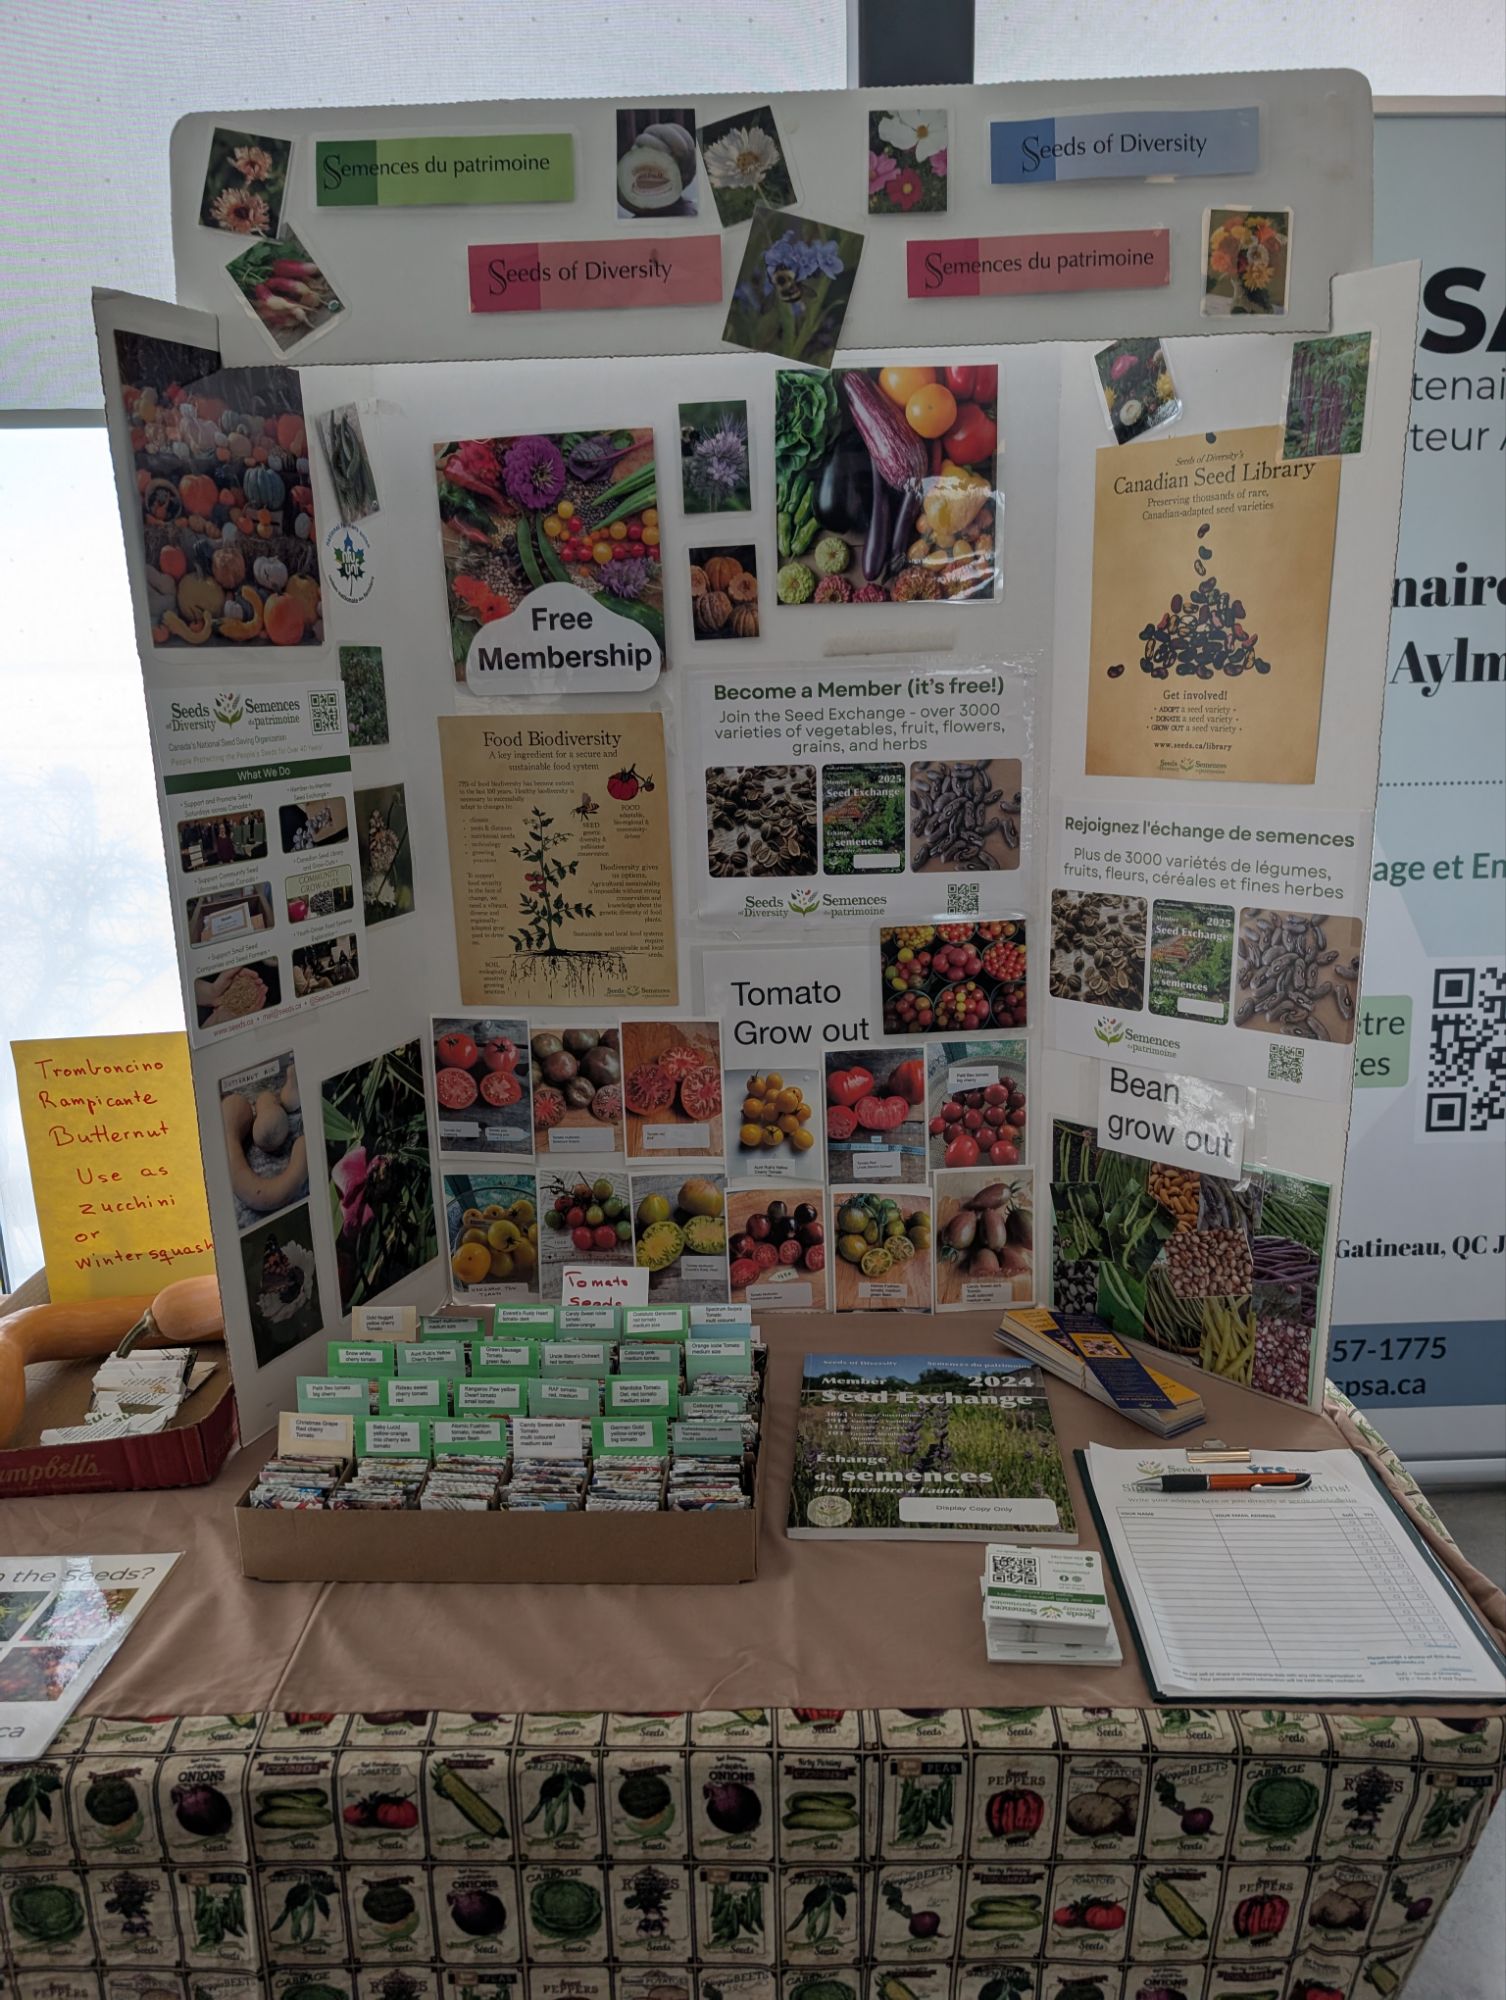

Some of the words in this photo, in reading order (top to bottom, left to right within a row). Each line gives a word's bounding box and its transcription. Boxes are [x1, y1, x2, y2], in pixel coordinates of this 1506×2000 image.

[1022, 135, 1087, 174] Seeds
[1093, 134, 1114, 154] of
[1121, 133, 1208, 158] Diversity
[323, 153, 419, 191] Semences
[425, 155, 448, 175] du
[453, 153, 551, 178] patrimoine
[488, 259, 552, 295] Seeds
[559, 260, 581, 281] of
[585, 259, 673, 285] Diversity
[925, 253, 1022, 290] Semences
[1028, 251, 1053, 271] du
[1058, 248, 1154, 274] patrimoine
[1419, 266, 1506, 354] S
[1410, 424, 1489, 452] teur
[1114, 475, 1188, 495] Canadian
[1194, 466, 1235, 487] Seed
[1243, 461, 1316, 482] Library
[1147, 496, 1190, 508] Preserving
[1192, 492, 1235, 503] thousands
[1142, 506, 1214, 521] Canadian-adapted
[1216, 503, 1235, 514] seed
[1238, 501, 1274, 512] varieties
[531, 607, 593, 631] Free
[478, 643, 652, 671] Membership
[714, 683, 796, 701] Become
[801, 687, 812, 698] a
[817, 679, 902, 698] Member
[949, 676, 1004, 697] free!)
[1163, 690, 1180, 701] Get
[1184, 690, 1227, 701] involved!
[171, 703, 210, 719] Seeds
[245, 699, 300, 714] Semences
[719, 709, 750, 724] Join
[754, 708, 781, 722] the
[784, 707, 825, 722] Seed
[828, 706, 905, 724] Exchange
[920, 706, 955, 719] over
[959, 703, 1000, 717] 3000
[172, 718, 216, 733] Diversity
[255, 715, 300, 729] patrimoine
[714, 725, 782, 740] varieties
[785, 723, 802, 738] of
[805, 722, 897, 741] vegetables,
[901, 720, 939, 736] fruit,
[942, 718, 1005, 736] flowers,
[483, 731, 522, 747] Food
[528, 730, 622, 748] Biodiversity
[792, 739, 845, 756] grains,
[849, 739, 879, 753] and
[883, 737, 928, 751] herbs
[1154, 740, 1232, 751] www.seeds.ca/library
[498, 750, 512, 761] key
[514, 750, 553, 760] ingredient
[556, 749, 567, 758] for
[603, 749, 618, 759] and
[237, 771, 262, 781] What
[264, 768, 278, 779] We
[280, 767, 291, 777] Do
[509, 762, 551, 771] sustainable
[553, 762, 570, 771] food
[573, 763, 599, 772] system
[878, 774, 902, 784] 2025
[826, 788, 850, 798] Seed
[853, 786, 900, 799] Exchange
[1065, 816, 1140, 836] Rejoignez
[1143, 820, 1225, 843] l'échange
[1229, 825, 1251, 842] de
[1255, 830, 1355, 848] semences
[835, 835, 883, 848] semences
[1074, 847, 1101, 862] Plus
[1104, 849, 1121, 863] de
[1125, 851, 1162, 866] 3000
[1165, 853, 1226, 872] variétés
[1231, 857, 1251, 873] de
[1255, 859, 1332, 882] légumes,
[1373, 855, 1427, 884] age
[1432, 852, 1463, 879] et
[1064, 863, 1103, 881] fruits,
[1105, 867, 1149, 885] fleurs,
[1152, 870, 1217, 889] céréales
[1220, 877, 1236, 890] et
[1240, 876, 1280, 895] fines
[1284, 881, 1344, 900] herbes
[745, 895, 784, 909] Seeds
[823, 894, 888, 908] Semences
[743, 906, 789, 920] Diversity
[831, 905, 885, 918] patrimoine
[1207, 916, 1231, 929] 2025
[1155, 925, 1179, 937] Seed
[1182, 928, 1229, 942] Exchange
[731, 980, 841, 1007] Tomato
[1161, 979, 1208, 992] semences
[734, 1019, 812, 1045] Grow
[823, 1017, 869, 1043] out
[1125, 1028, 1180, 1050] Semences
[1132, 1043, 1177, 1059] patrimoine
[35, 1058, 164, 1080] Tromboncino
[1110, 1066, 1180, 1105] Bean
[39, 1090, 158, 1115] Rampicante
[49, 1121, 169, 1147] Butternut
[1108, 1113, 1175, 1145] grow
[1185, 1130, 1233, 1159] out
[76, 1167, 122, 1185] Use
[140, 1166, 169, 1177] as
[75, 1230, 100, 1243] or
[1336, 1238, 1446, 1260] Gatineau,
[1452, 1236, 1488, 1260] QC
[565, 1271, 629, 1289] Tomato
[822, 1376, 887, 1386] Member
[968, 1375, 1035, 1388] 2024
[821, 1390, 888, 1403] Seed
[898, 1391, 1033, 1409] Exchange
[816, 1453, 888, 1465] Échange
[814, 1472, 836, 1482] de
[842, 1469, 993, 1484] semences
[814, 1485, 842, 1494] d'un
[844, 1486, 902, 1494] membre
[908, 1485, 919, 1495] à
[921, 1485, 964, 1495] l'autre
[936, 1505, 966, 1513] Display
[13, 1570, 56, 1583] the
[62, 1567, 156, 1584] Seeds?
[640, 1727, 665, 1738] Seeds
[917, 1727, 942, 1737] Seeds
[1186, 1730, 1212, 1740] Seeds
[178, 1770, 225, 1783] ONIONS
[709, 1771, 755, 1782] ONIONS
[1239, 1883, 1294, 1893] PEPPERS
